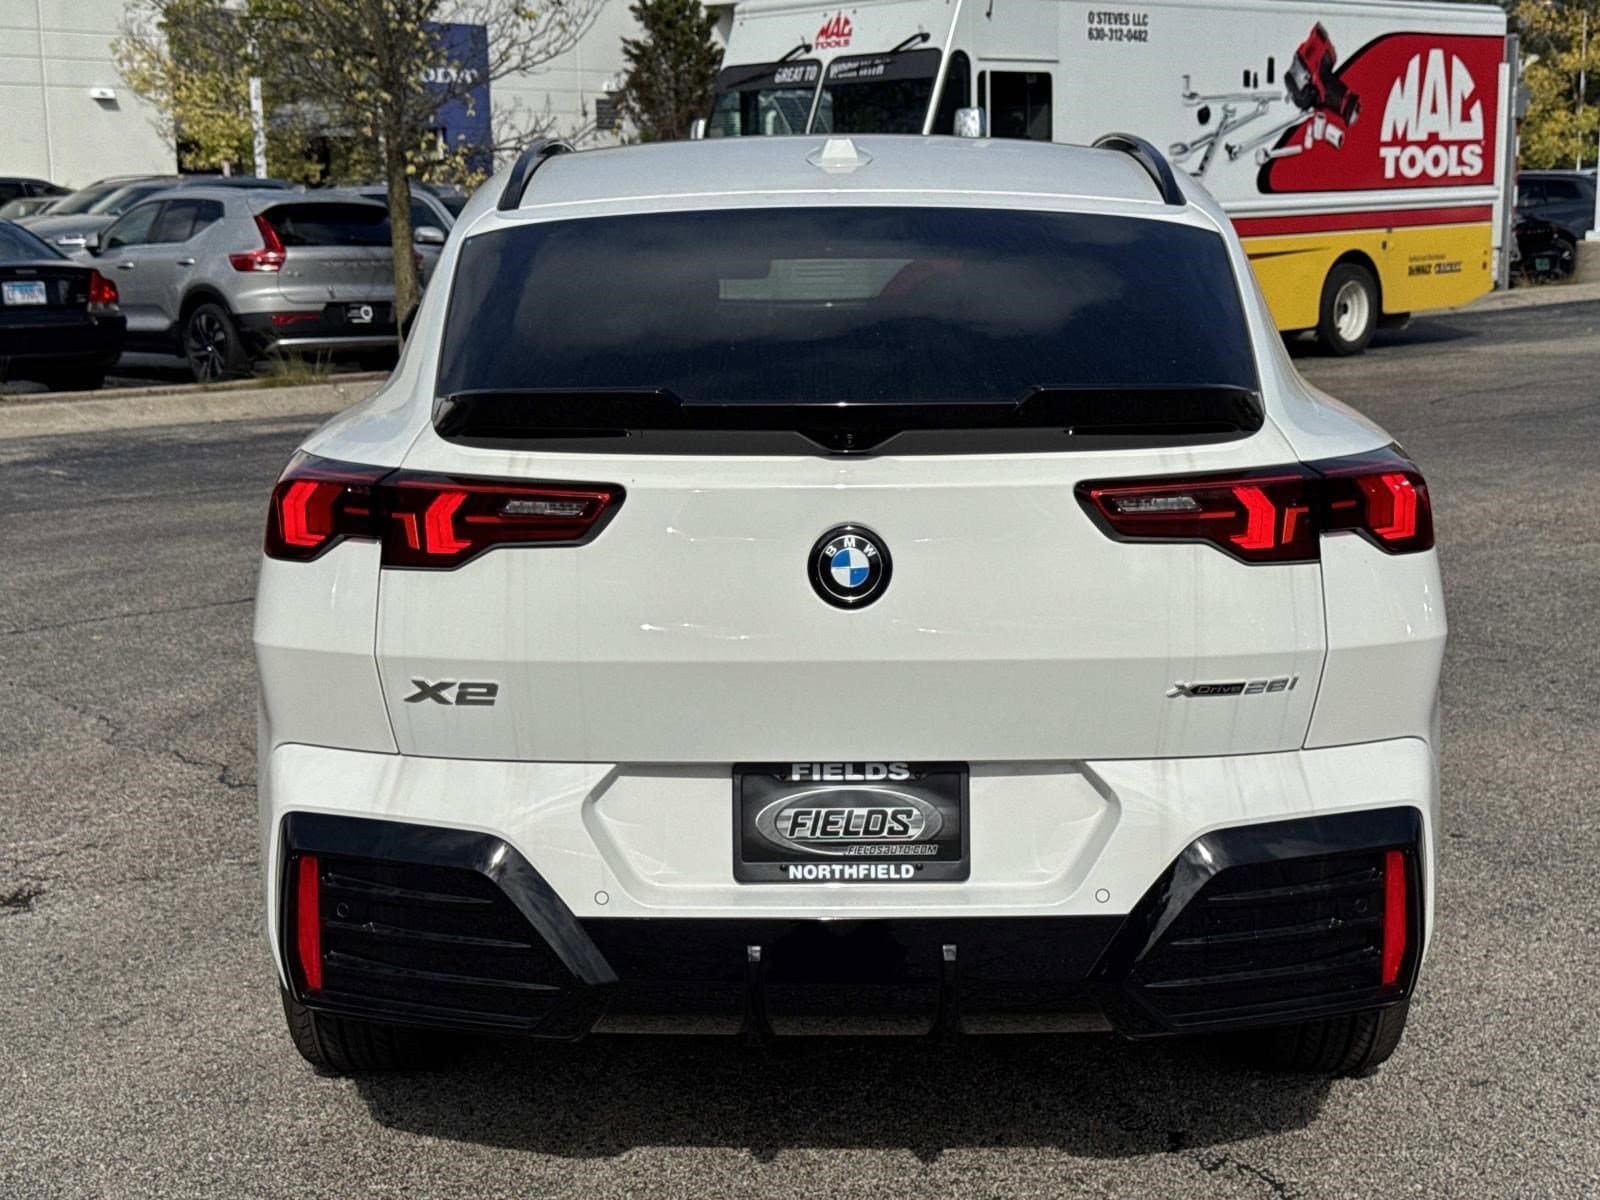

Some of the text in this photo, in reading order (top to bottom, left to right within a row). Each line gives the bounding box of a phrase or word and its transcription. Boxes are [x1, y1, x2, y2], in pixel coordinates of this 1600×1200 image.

[816, 16, 853, 41] MAC
[1096, 11, 1131, 26] STEVES
[1132, 13, 1149, 27] LLC
[815, 39, 850, 50] TOOLS
[774, 66, 805, 84] GREAT
[804, 65, 818, 81] TO
[1380, 48, 1484, 142] MAC
[1379, 144, 1484, 179] TOOLS
[824, 536, 877, 558] BMW
[403, 679, 499, 706] X2
[791, 763, 911, 781] FIELDS
[786, 807, 915, 839] FIELDS
[788, 864, 916, 880] NORTHFIELD
